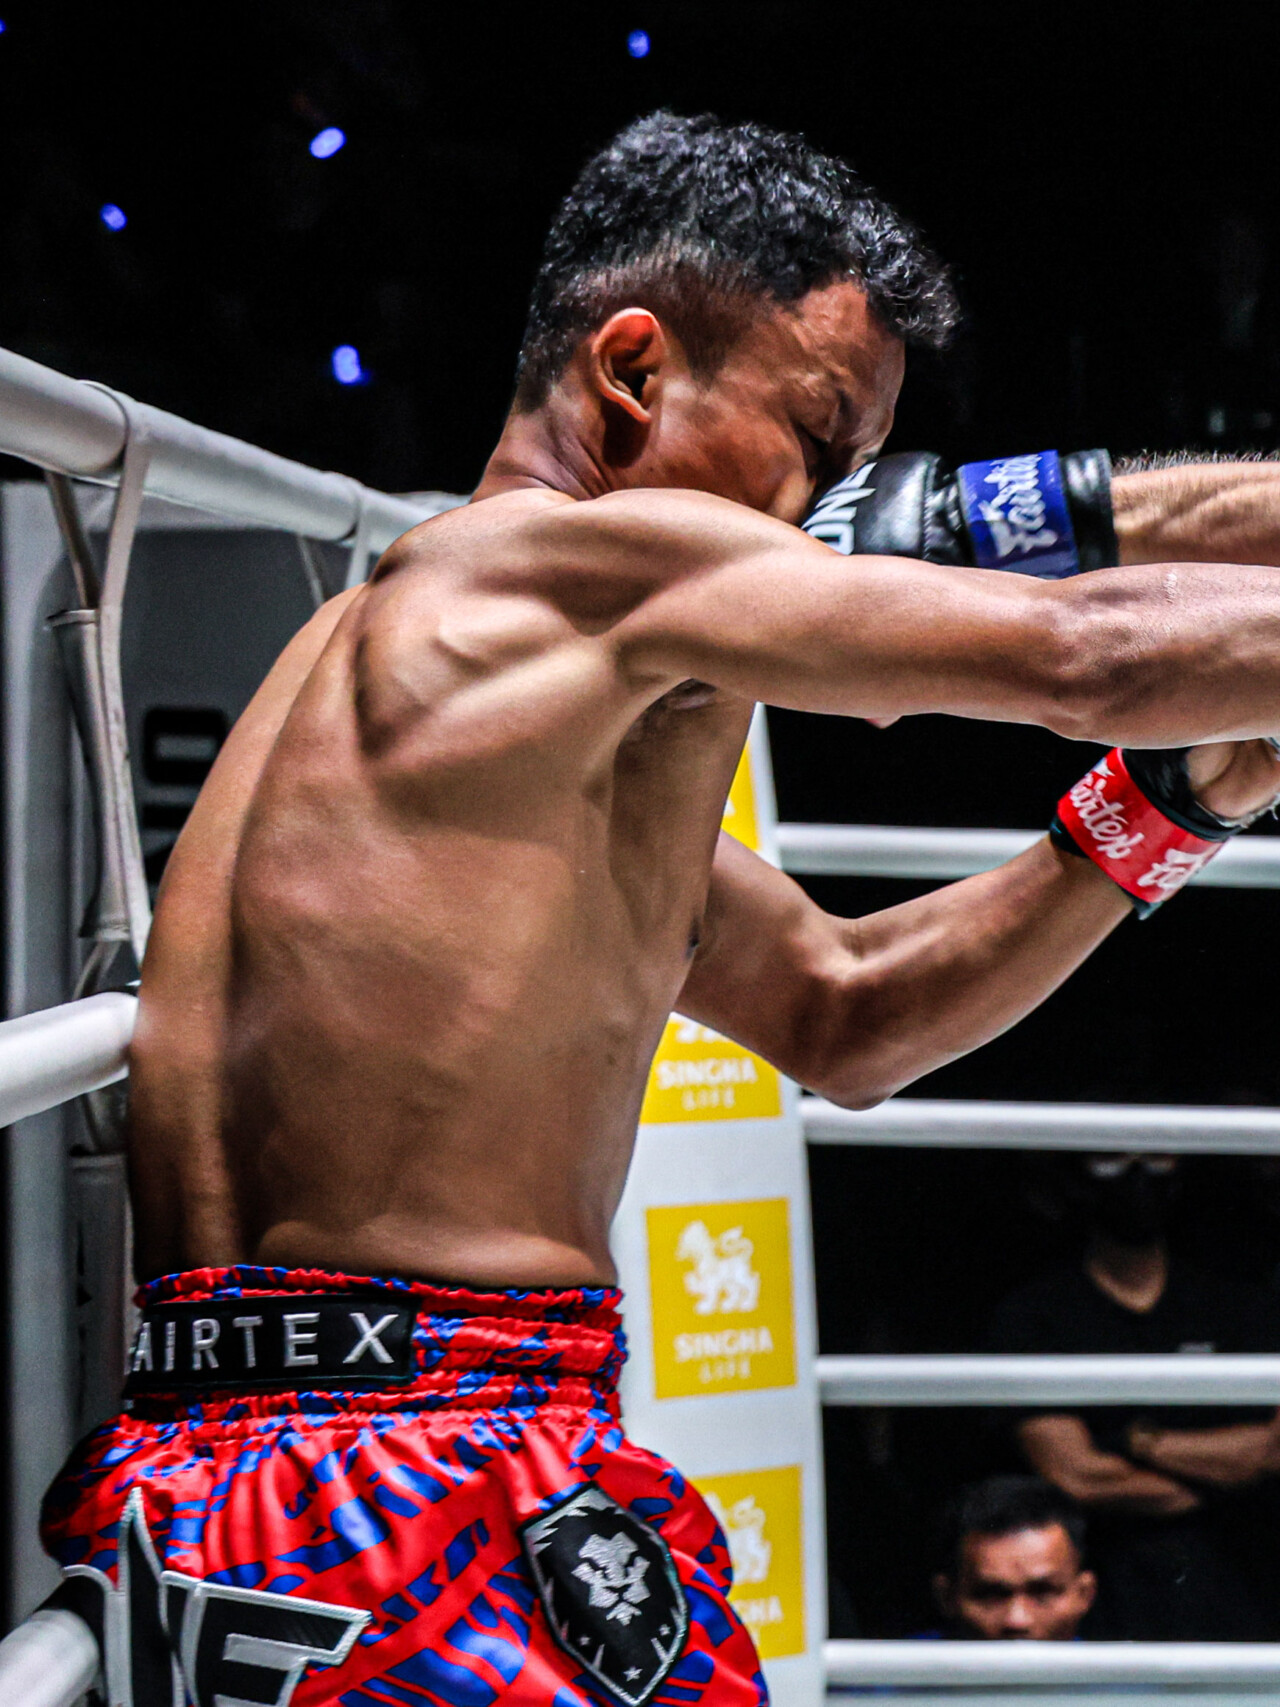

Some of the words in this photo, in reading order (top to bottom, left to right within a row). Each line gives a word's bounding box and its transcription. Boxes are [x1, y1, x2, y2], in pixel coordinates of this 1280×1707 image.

[656, 1057, 758, 1090] SINGHA
[125, 1311, 399, 1376] AIRTEX
[673, 1326, 774, 1363] SINGHA
